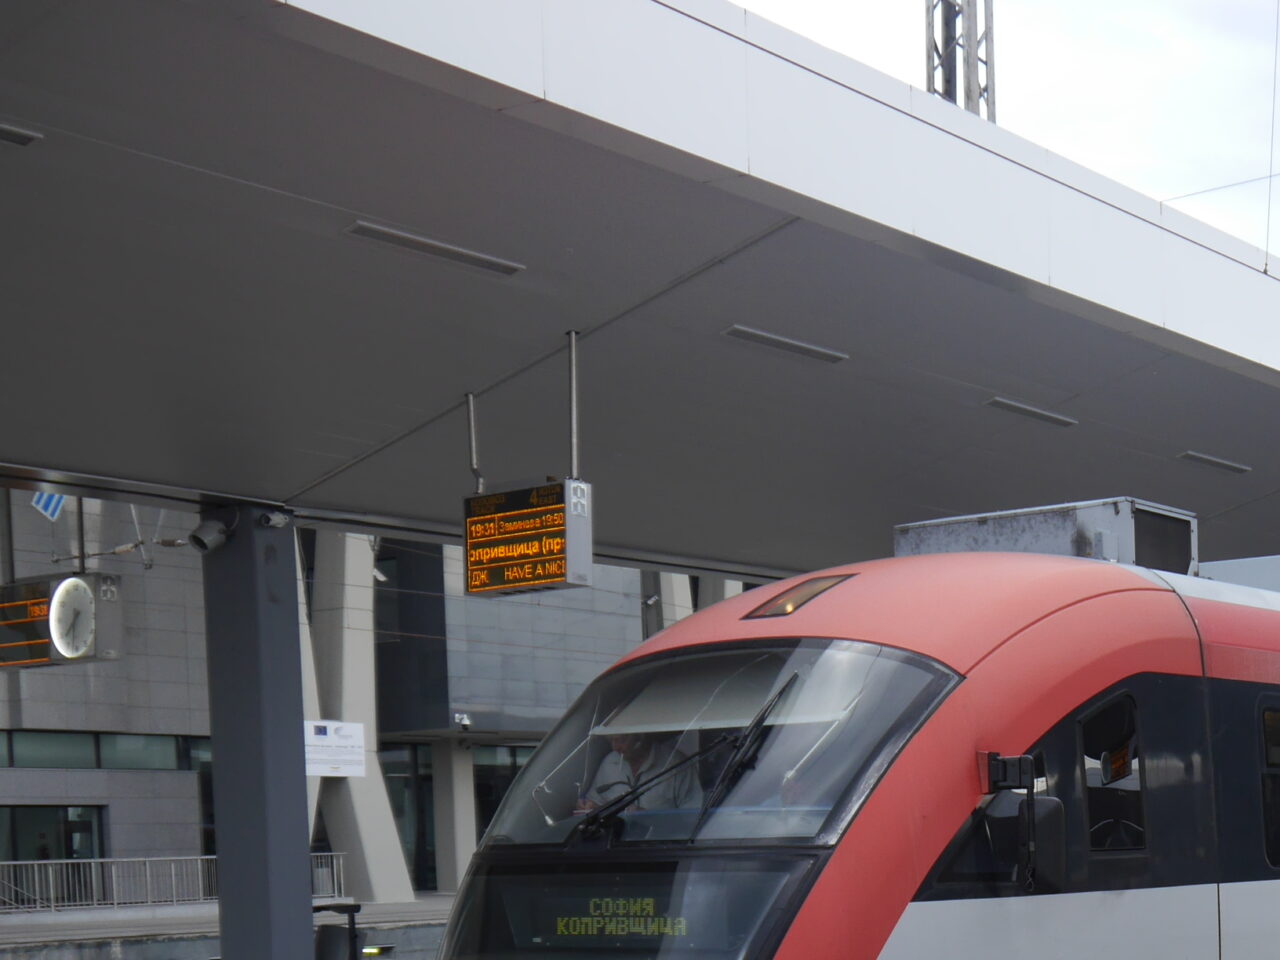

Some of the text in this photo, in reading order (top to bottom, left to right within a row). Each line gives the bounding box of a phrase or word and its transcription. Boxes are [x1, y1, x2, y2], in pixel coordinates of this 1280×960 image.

[530, 487, 538, 505] 4
[471, 522, 495, 537] 19:31
[504, 564, 532, 580] HAVE
[535, 563, 543, 576] A
[589, 897, 655, 917] СОФИЯ
[556, 916, 687, 936] КОПРИВЩИЦА
